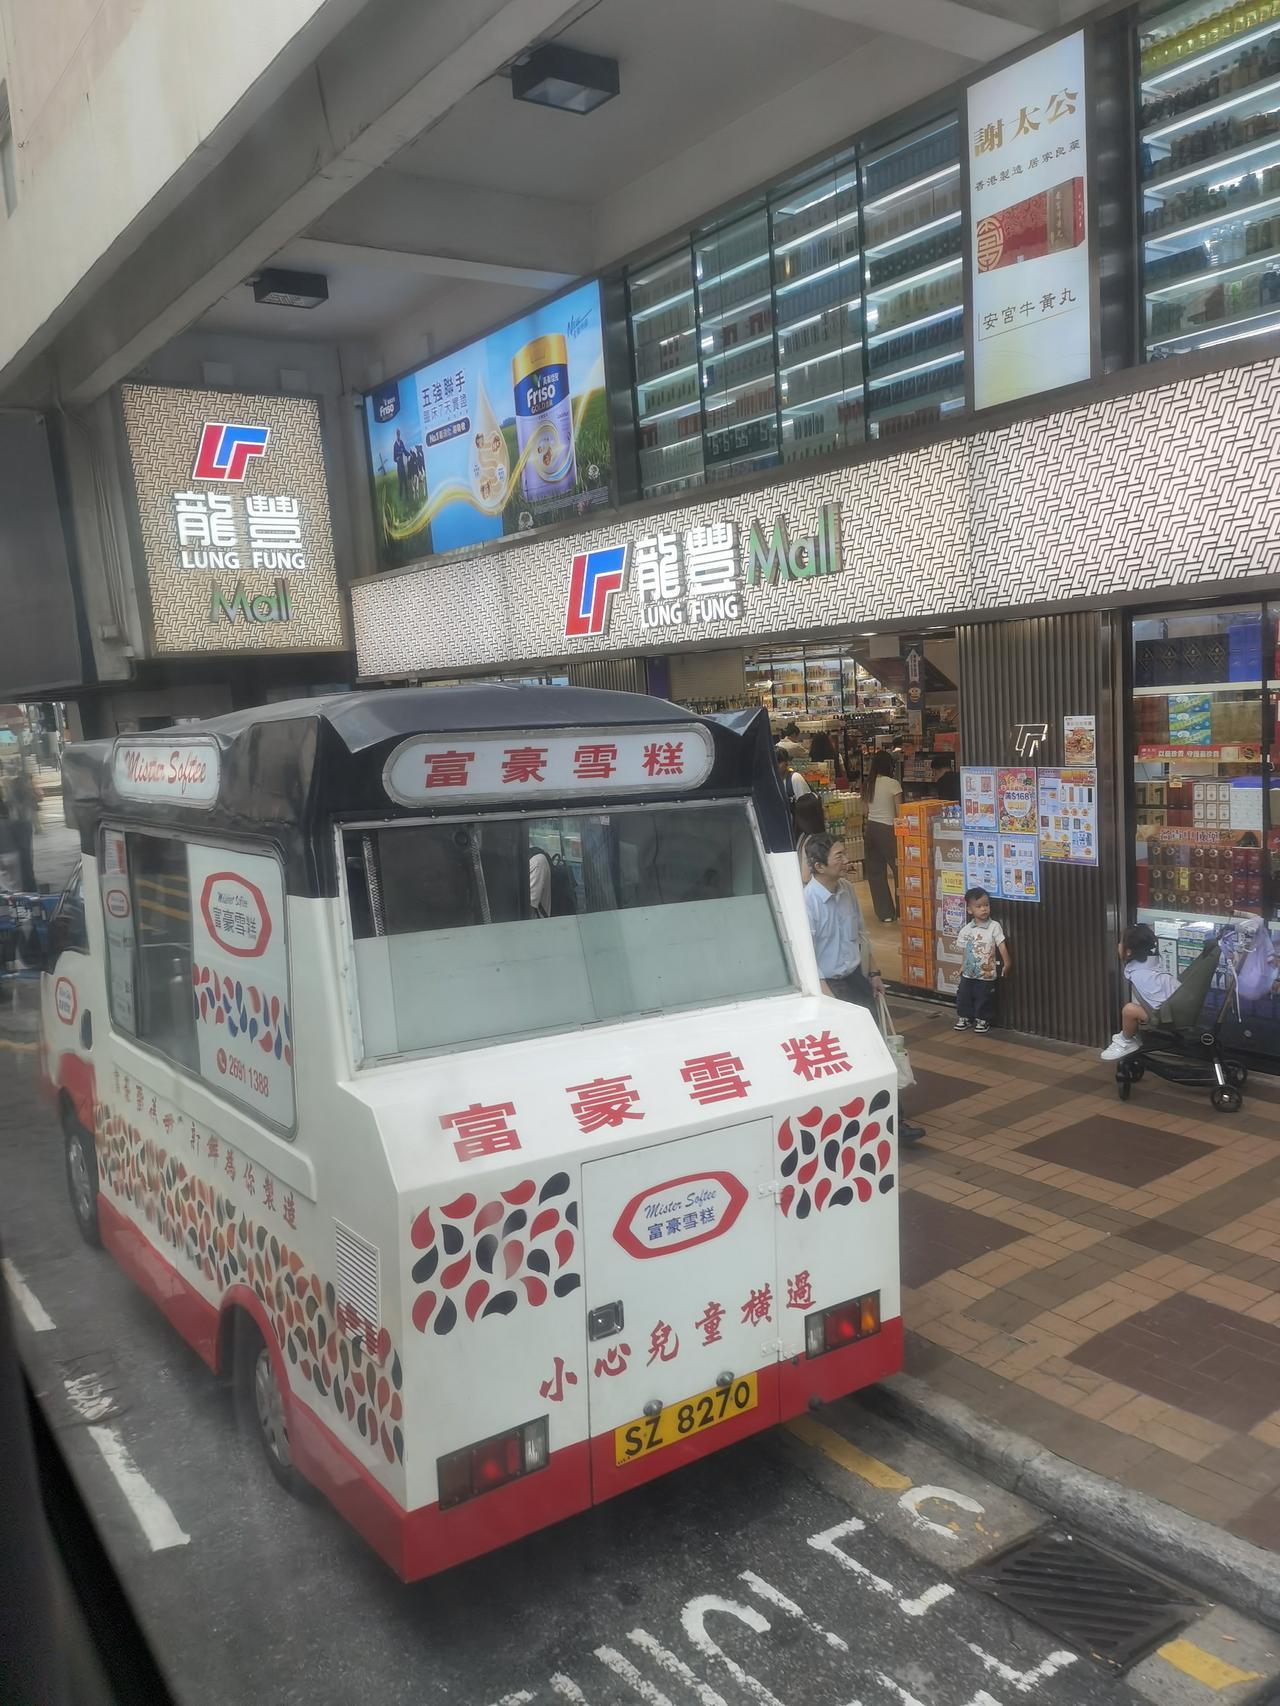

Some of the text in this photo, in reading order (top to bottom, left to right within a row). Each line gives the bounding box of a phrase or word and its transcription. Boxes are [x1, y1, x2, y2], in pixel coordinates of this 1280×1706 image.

[975, 87, 1079, 157] 謝太公
[975, 164, 1025, 192] 香港製造
[982, 287, 1076, 330] 安宮牛黃丸
[422, 370, 465, 407] 五強聯手
[527, 385, 556, 408] Friso
[173, 491, 302, 549] 龍豐
[181, 551, 306, 570] LUNG FUNG
[635, 521, 738, 601] 龍豐
[746, 503, 841, 586] Mall
[211, 579, 292, 623] Mall
[641, 597, 739, 628] LUNG FUNG
[125, 750, 206, 796] Mister Softee
[424, 741, 684, 788] 富豪雪糕
[229, 1054, 270, 1098] 2691 1388
[438, 1030, 854, 1163] 富豪雪糕
[644, 1188, 716, 1219] Mister Softee
[647, 1206, 715, 1241] 富豪雪糕
[625, 1381, 750, 1457] SZ 8270
